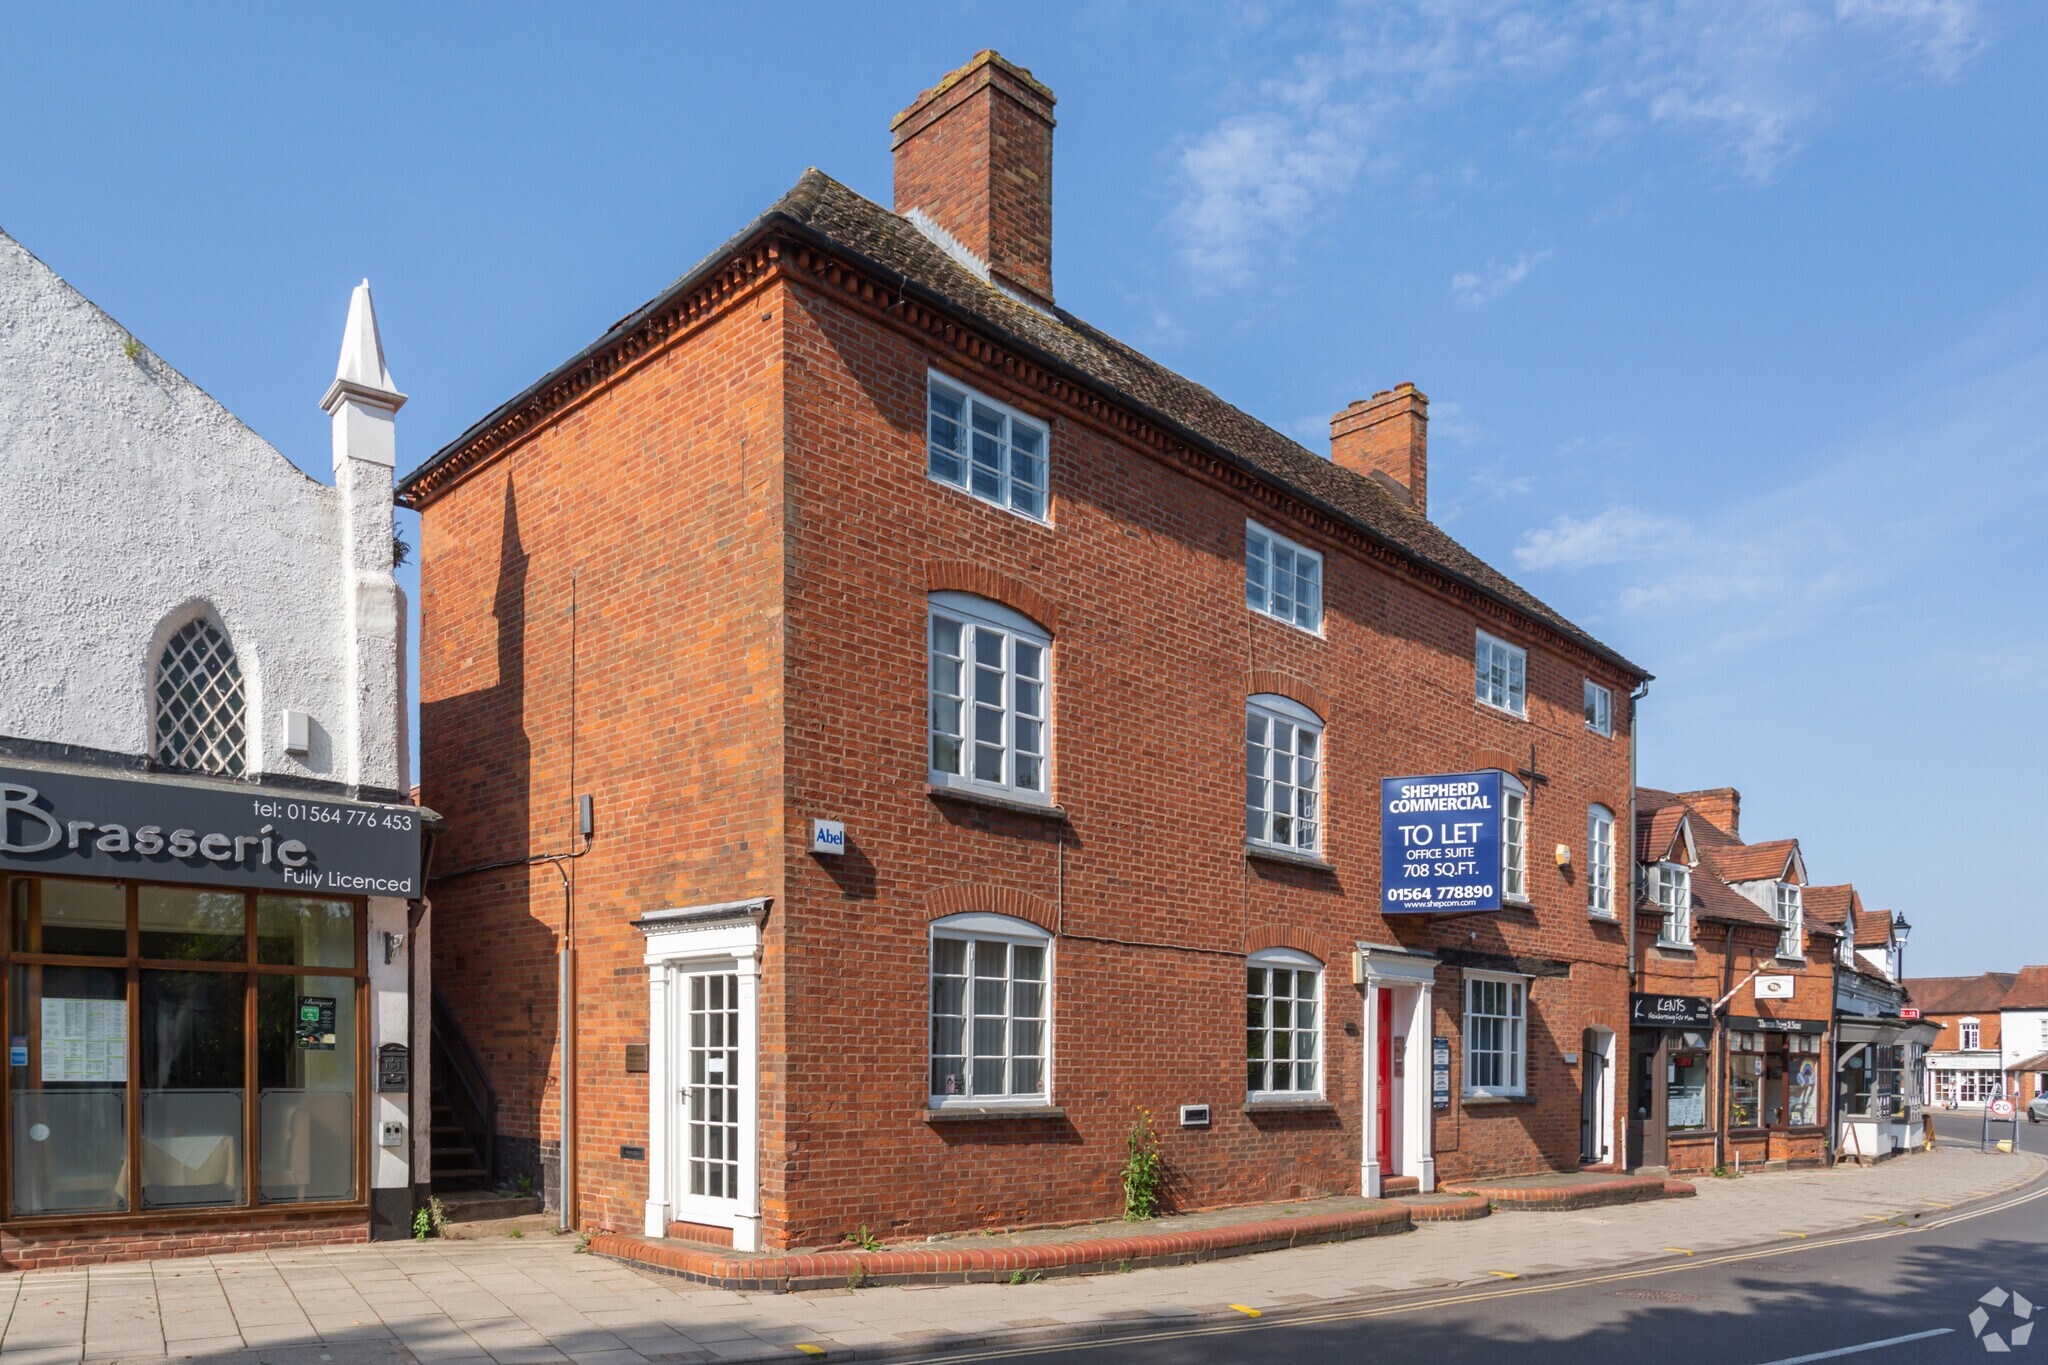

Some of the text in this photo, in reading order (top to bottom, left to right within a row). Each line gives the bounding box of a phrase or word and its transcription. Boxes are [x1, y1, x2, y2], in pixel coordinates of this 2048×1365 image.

[1401, 782, 1479, 798] SHEPHERD
[1389, 795, 1492, 814] COMMERCIAL
[253, 800, 412, 831] tel: 01564 776 453
[816, 827, 843, 845] Abel
[1398, 822, 1483, 846] TO LET
[1406, 847, 1474, 860] OFFICE SUITE
[1403, 861, 1479, 877] 708 SQ.FT.
[284, 868, 411, 892] Fully Licenced
[1387, 885, 1493, 901] 01564 778890
[1404, 899, 1476, 909] www.shepcom.com
[1994, 1103, 2010, 1111] 20
